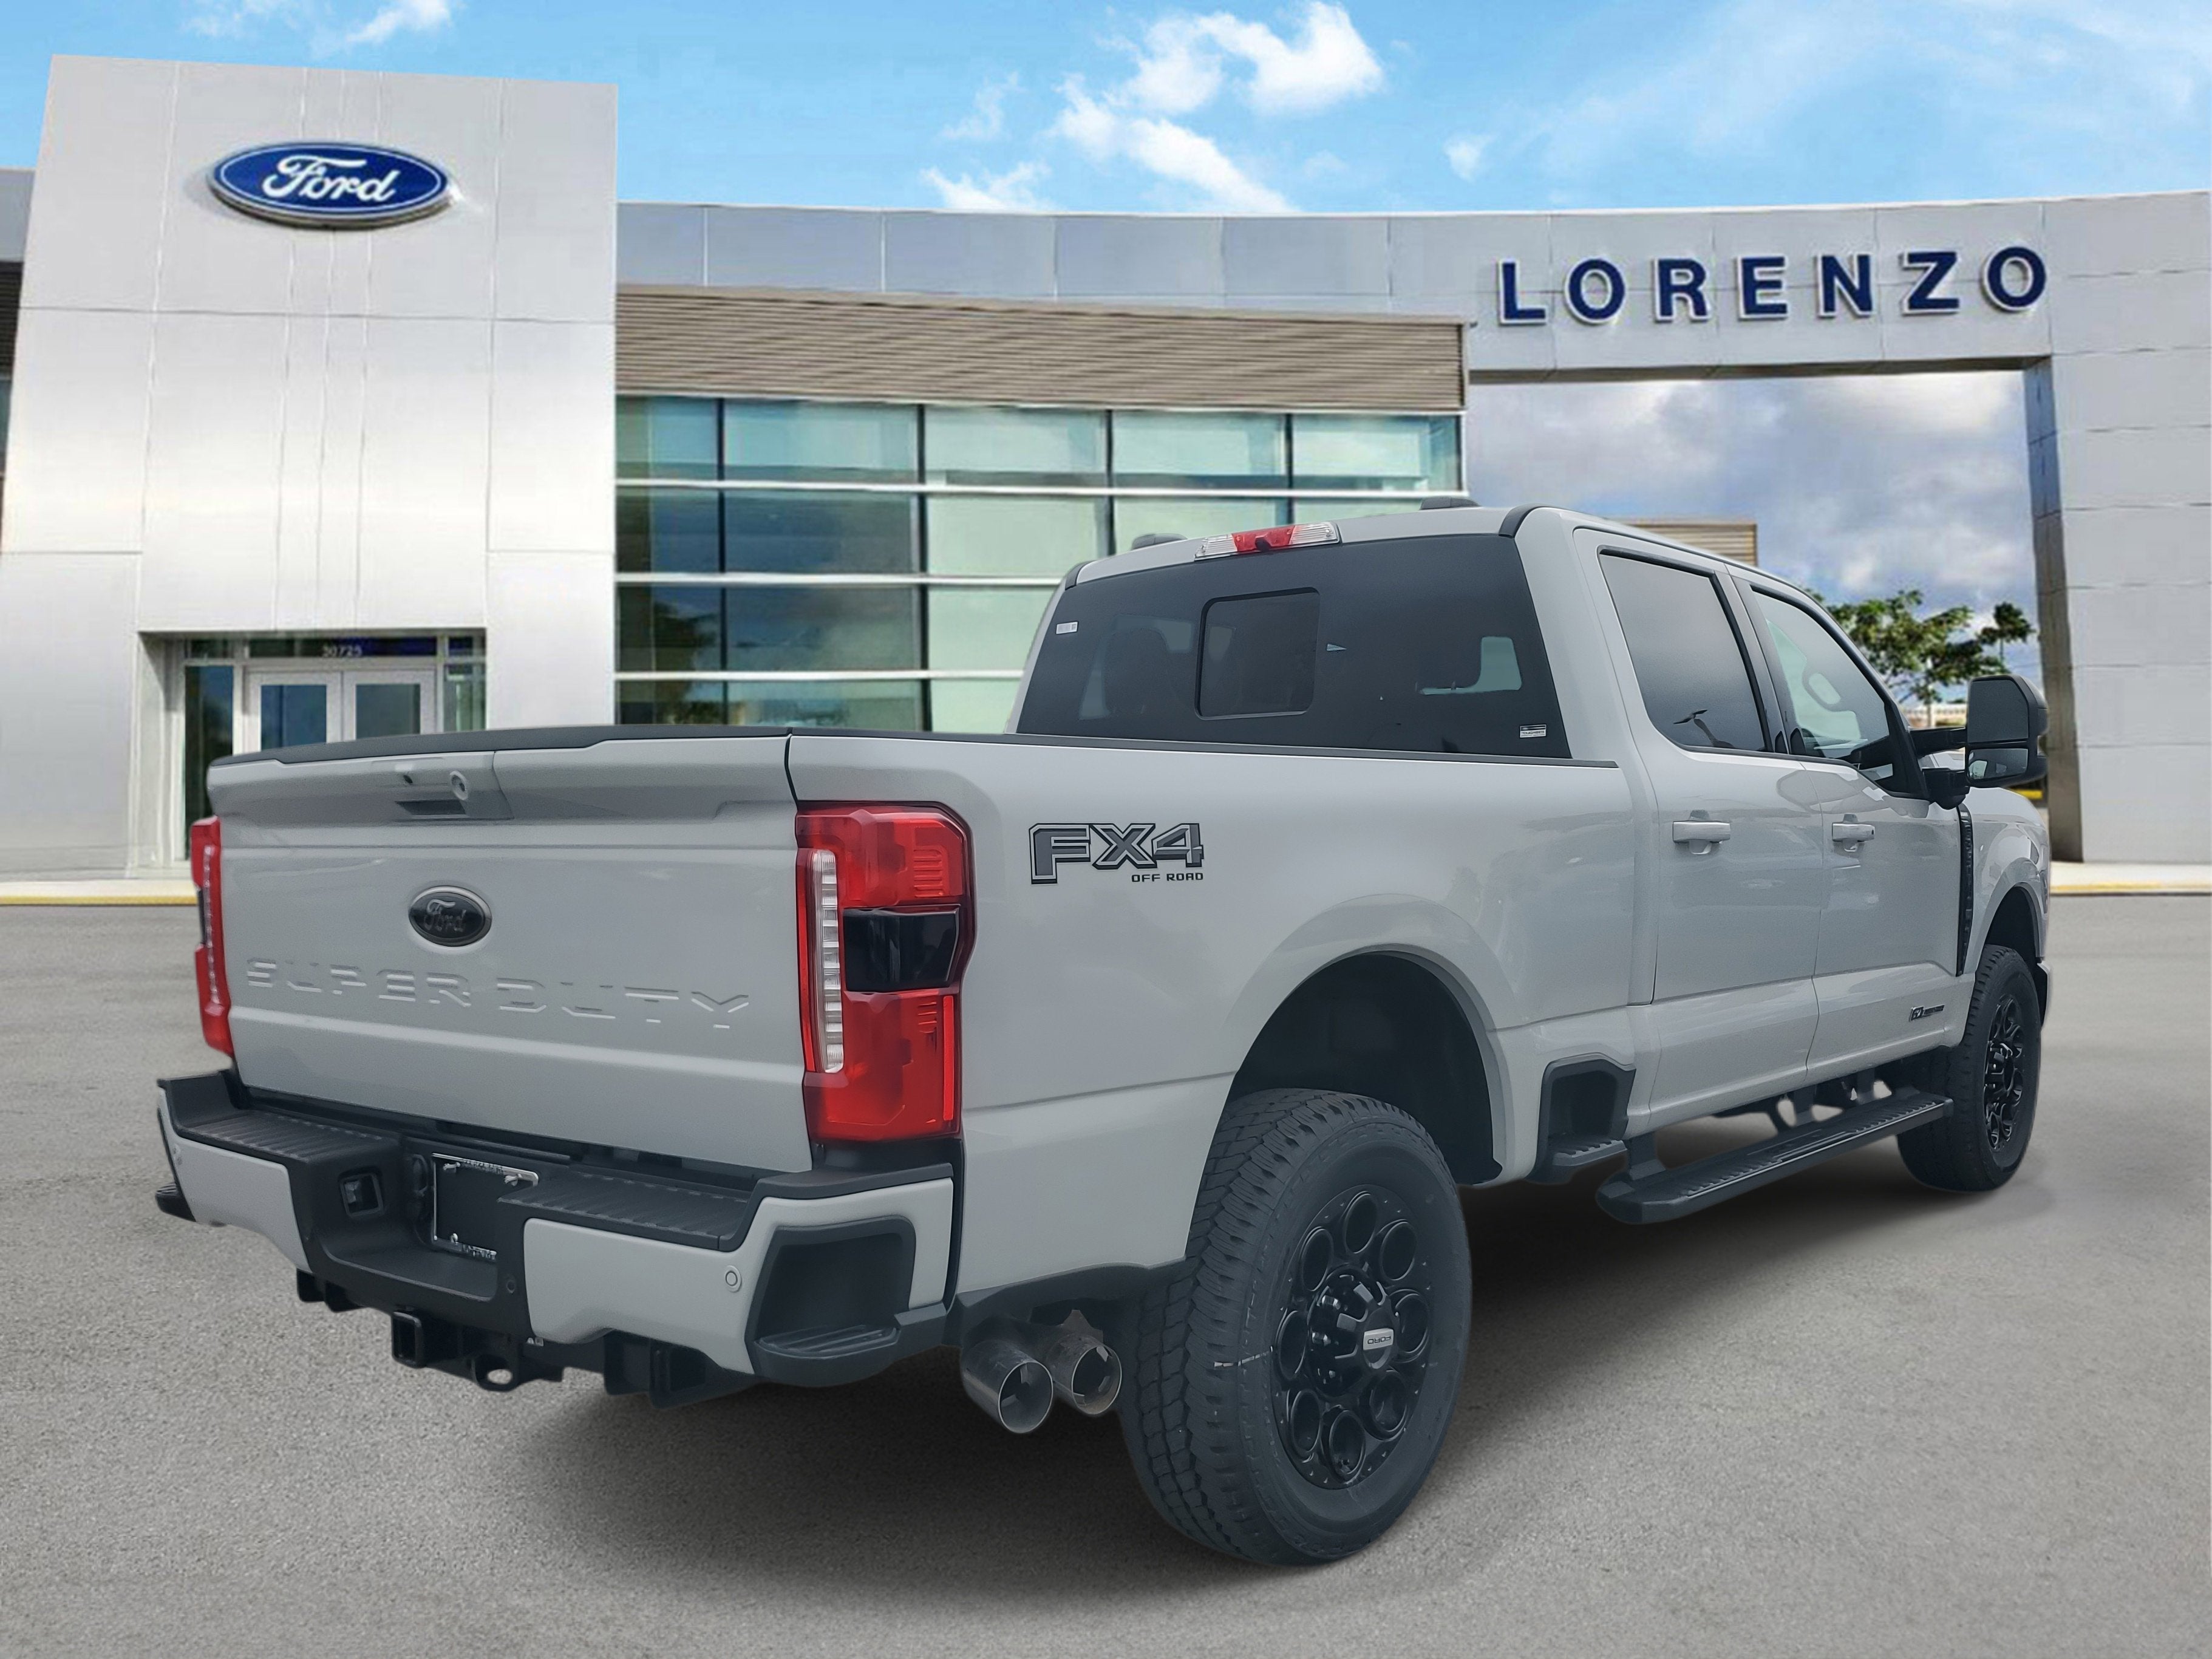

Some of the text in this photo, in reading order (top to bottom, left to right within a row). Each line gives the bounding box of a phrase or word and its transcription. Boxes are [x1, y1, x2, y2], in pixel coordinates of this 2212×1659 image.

[262, 154, 401, 202] Ford
[1498, 245, 2047, 323] LORENZO
[1029, 822, 1204, 885] FX4
[1131, 872, 1203, 882] OFF ROAD
[423, 898, 467, 932] Ford
[247, 957, 749, 1029] SUPER DUTY
[1367, 1336, 1391, 1344] FORD
